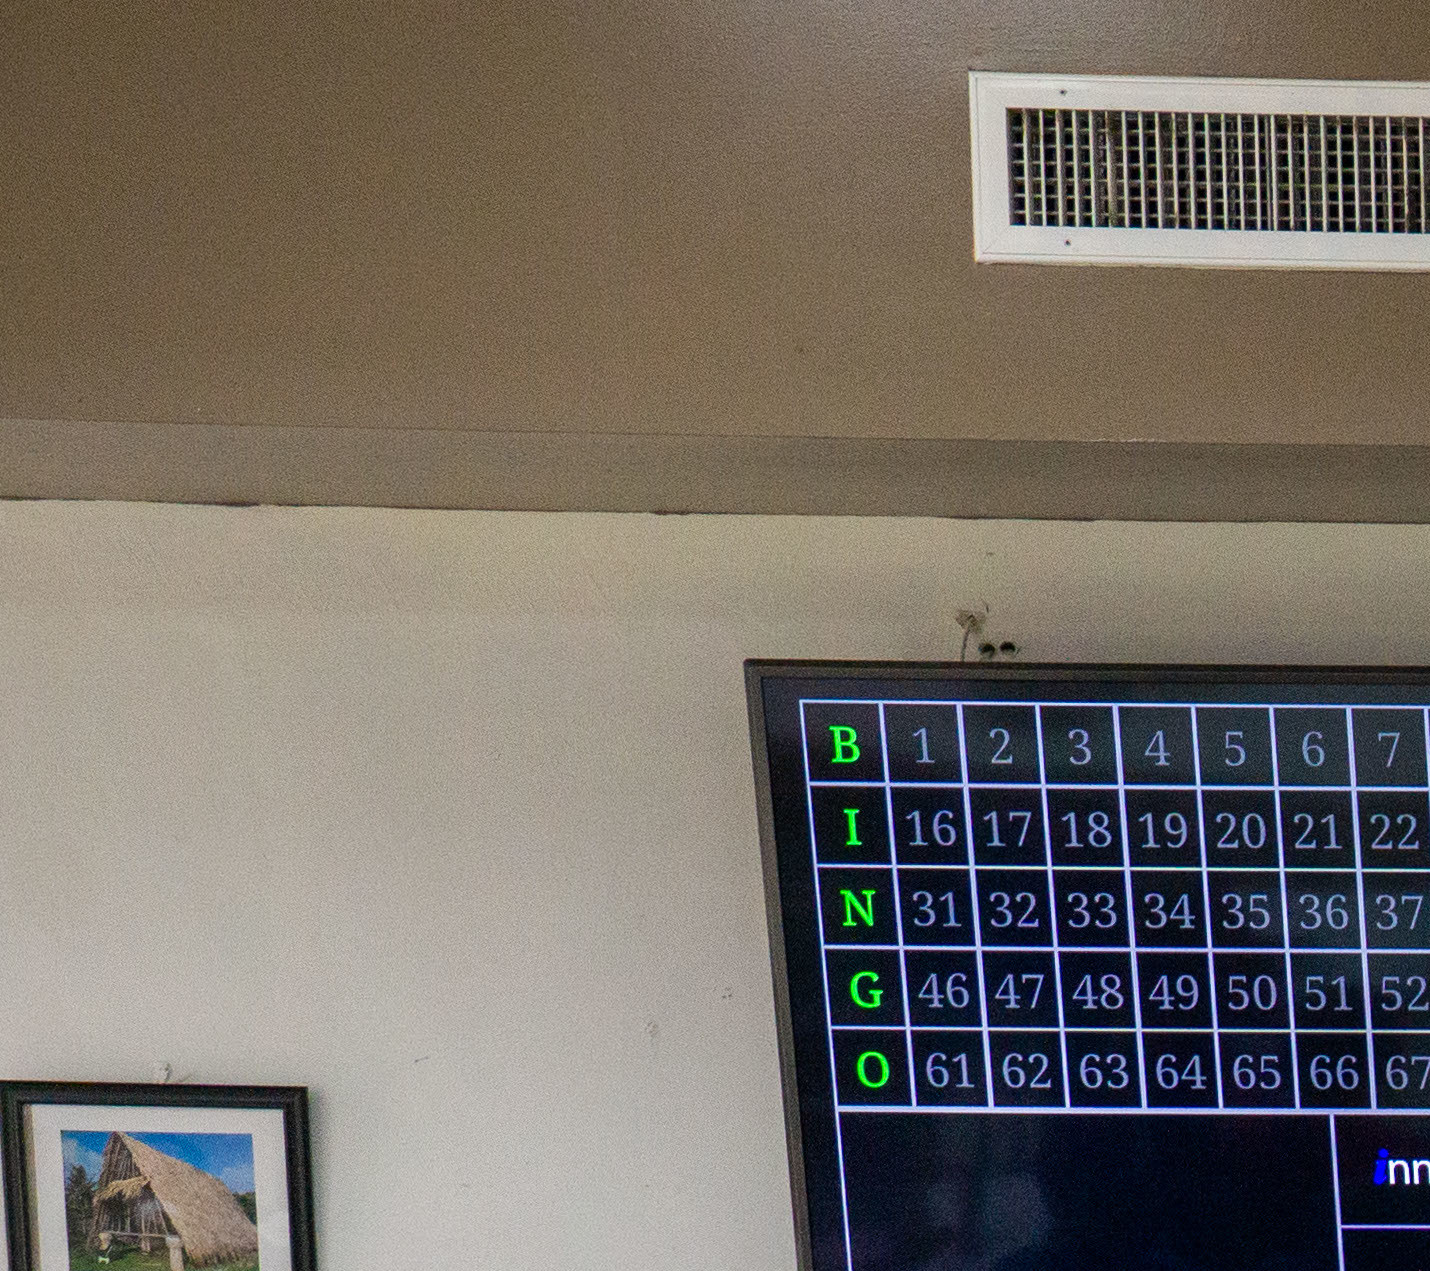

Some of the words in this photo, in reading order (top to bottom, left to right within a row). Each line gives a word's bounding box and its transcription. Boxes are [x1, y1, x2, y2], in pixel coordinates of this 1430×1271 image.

[827, 724, 862, 765] B
[911, 726, 935, 764] 1
[988, 727, 1015, 765] 2
[1067, 727, 1093, 766] 3
[1143, 729, 1172, 767] 4
[1223, 729, 1248, 768] 5
[1300, 729, 1327, 768] 6
[1376, 730, 1402, 769] 7
[842, 807, 863, 847] I
[905, 808, 958, 847] 16
[983, 810, 1033, 847] 17
[1061, 810, 1113, 848] 18
[1138, 812, 1189, 849] 19
[1214, 812, 1268, 850] 20
[1293, 812, 1342, 850] 21
[1369, 813, 1420, 850] 22
[839, 888, 877, 928] N
[911, 890, 961, 928] 31
[988, 891, 1041, 929] 32
[1067, 891, 1118, 929] 33
[1143, 891, 1196, 929] 34
[1221, 892, 1272, 931] 35
[1297, 892, 1351, 931] 36
[1374, 893, 1425, 932] 37
[848, 969, 884, 1010] G
[917, 971, 971, 1009] 46
[994, 972, 1046, 1010] 47
[1071, 972, 1125, 1010] 48
[1148, 973, 1200, 1011] 49
[1227, 974, 1279, 1011] 50
[1304, 974, 1352, 1011] 51
[1380, 974, 1430, 1012] 52
[855, 1050, 891, 1090] O
[924, 1051, 976, 1089] 61
[1001, 1051, 1053, 1089] 62
[1078, 1052, 1130, 1090] 63
[1155, 1053, 1207, 1090] 64
[1231, 1053, 1282, 1090] 65
[1309, 1054, 1360, 1090] 66
